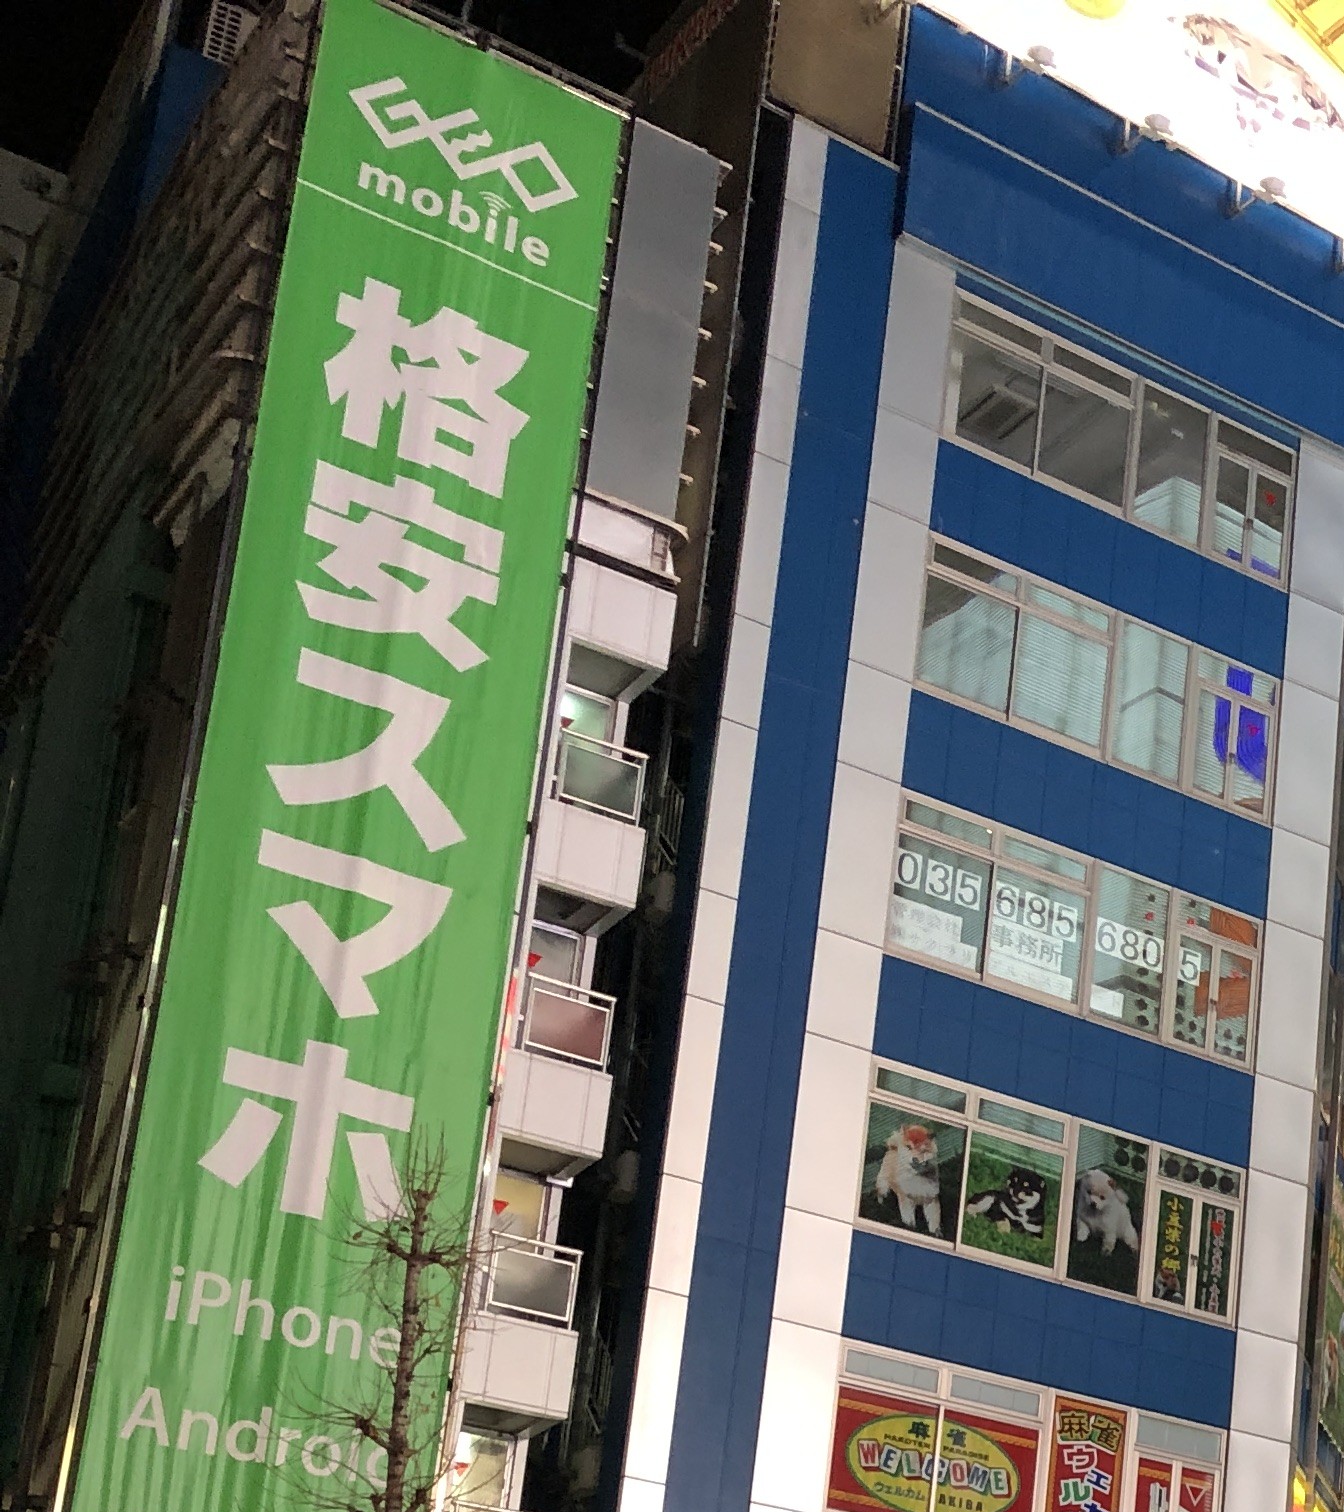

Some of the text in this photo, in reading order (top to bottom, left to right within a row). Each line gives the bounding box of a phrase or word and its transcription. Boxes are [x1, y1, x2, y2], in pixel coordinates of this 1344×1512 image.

[357, 160, 551, 268] mobile
[198, 277, 530, 1222] 格安スマホ
[164, 1266, 402, 1369] iPhone
[858, 1440, 1010, 1497] WELCOME
[1057, 1411, 1121, 1450] 麻雀
[937, 1493, 984, 1512] AKIBA
